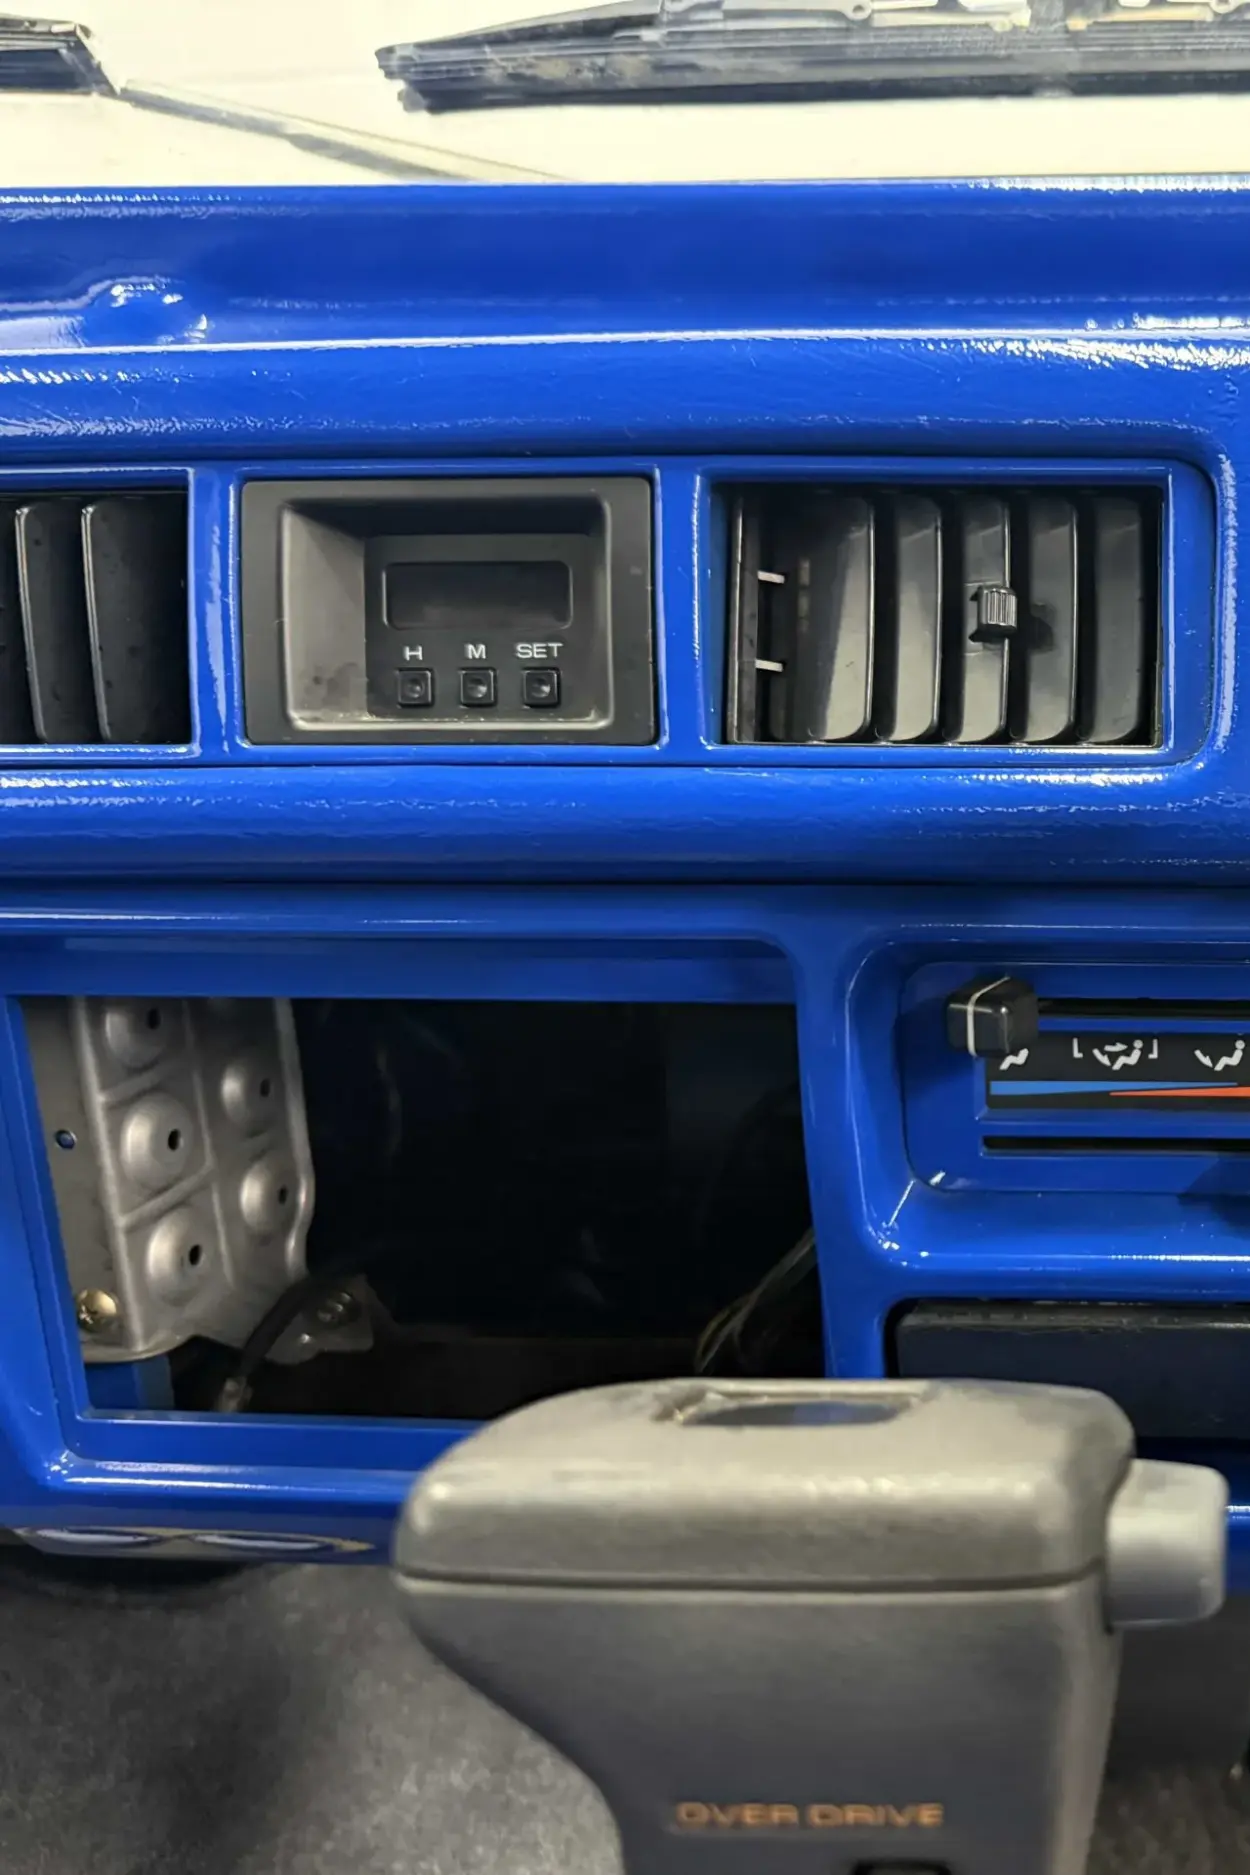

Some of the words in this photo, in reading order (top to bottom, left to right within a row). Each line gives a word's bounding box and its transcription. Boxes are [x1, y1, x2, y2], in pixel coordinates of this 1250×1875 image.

[404, 646, 423, 661] H
[467, 644, 486, 660] M
[516, 643, 563, 659] SET
[676, 1802, 799, 1829] OVER
[807, 1804, 944, 1828] DRIVE
